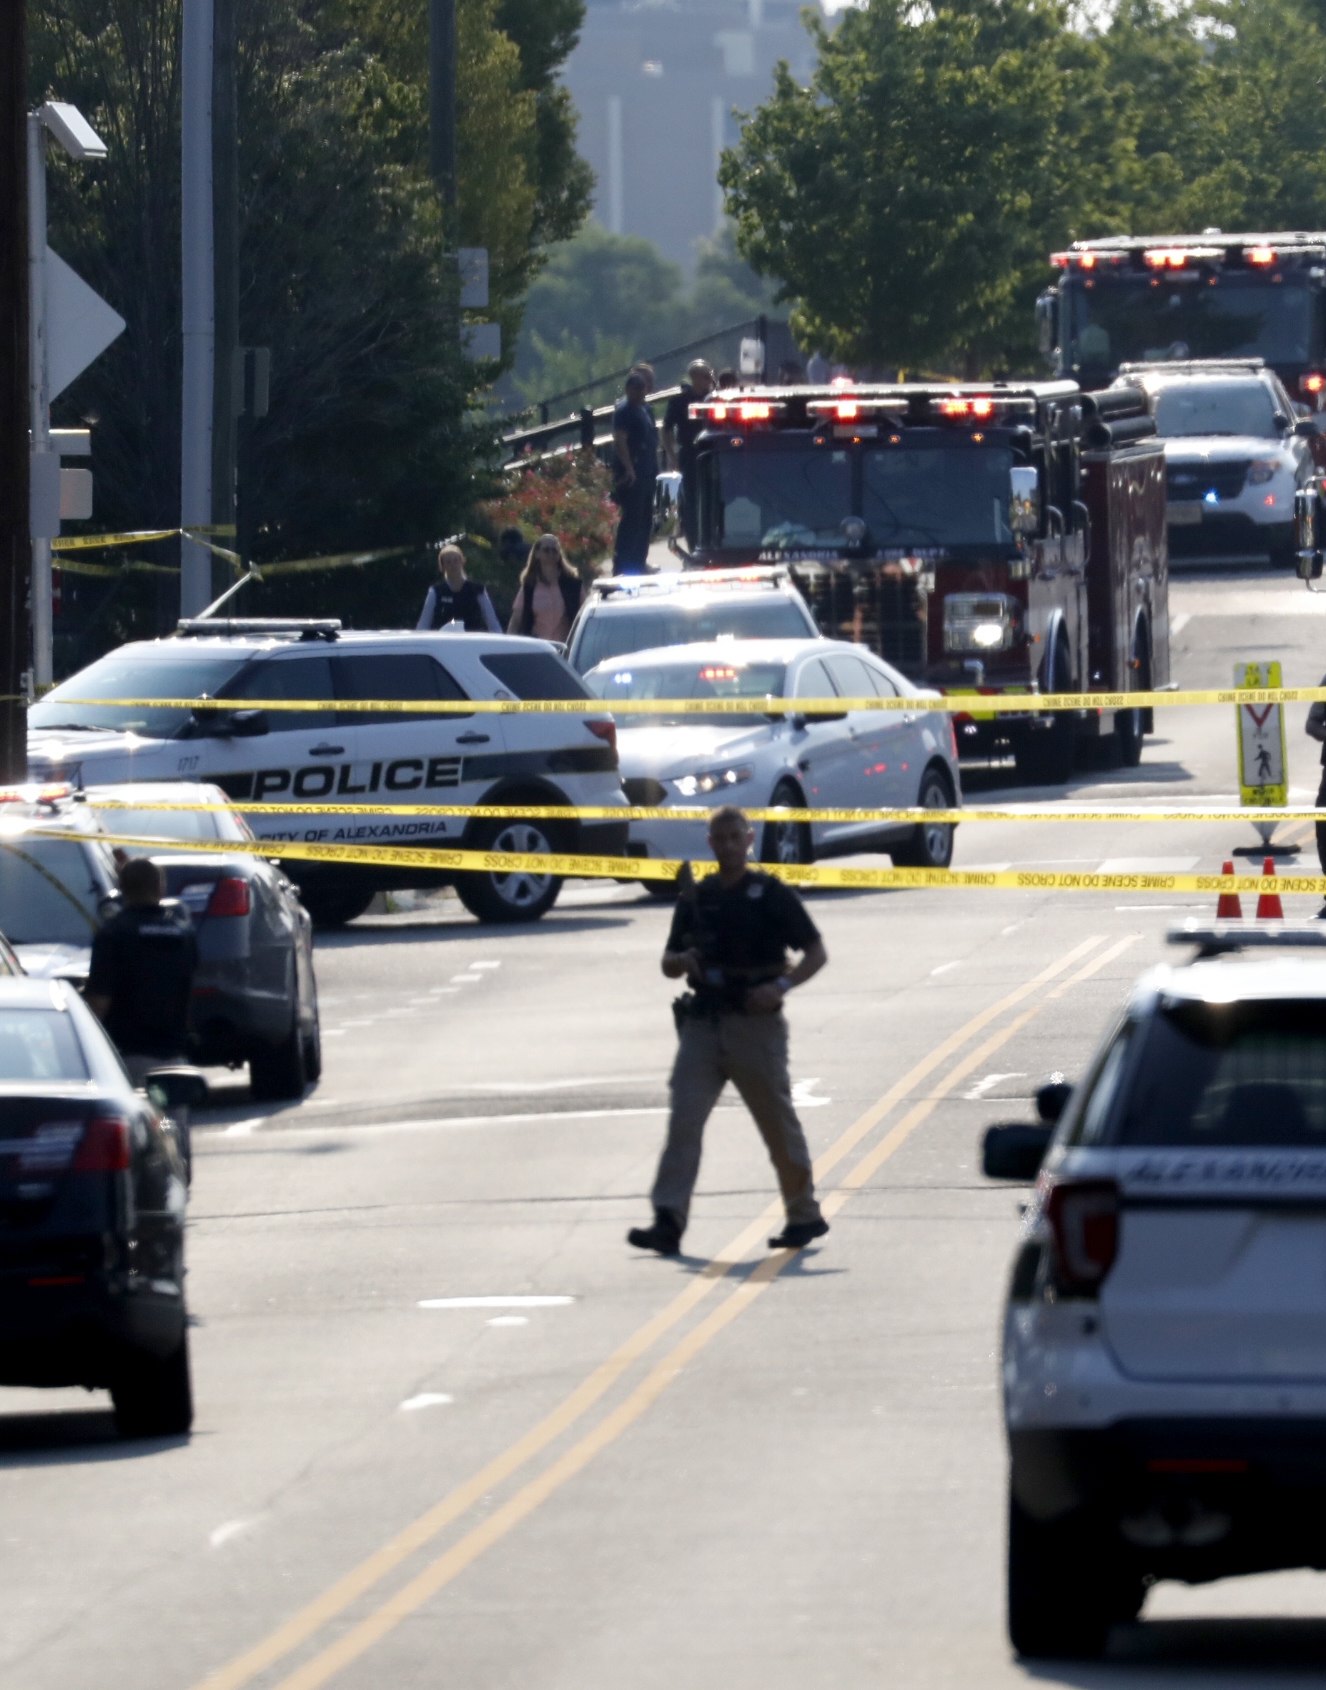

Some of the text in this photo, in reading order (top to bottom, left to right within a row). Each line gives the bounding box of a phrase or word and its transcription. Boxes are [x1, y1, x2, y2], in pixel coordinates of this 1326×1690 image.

[253, 757, 462, 800] POLICE
[305, 829, 329, 842] OF
[333, 821, 448, 841] ALEXANDRIA
[964, 873, 996, 883] CRIME
[1016, 873, 1175, 887] CRIME SCENE DO NOT CROSS
[1195, 876, 1233, 889] CROSS
[1236, 877, 1258, 889] NOT
[1260, 877, 1277, 890] DO
[1279, 877, 1316, 890] SCENE
